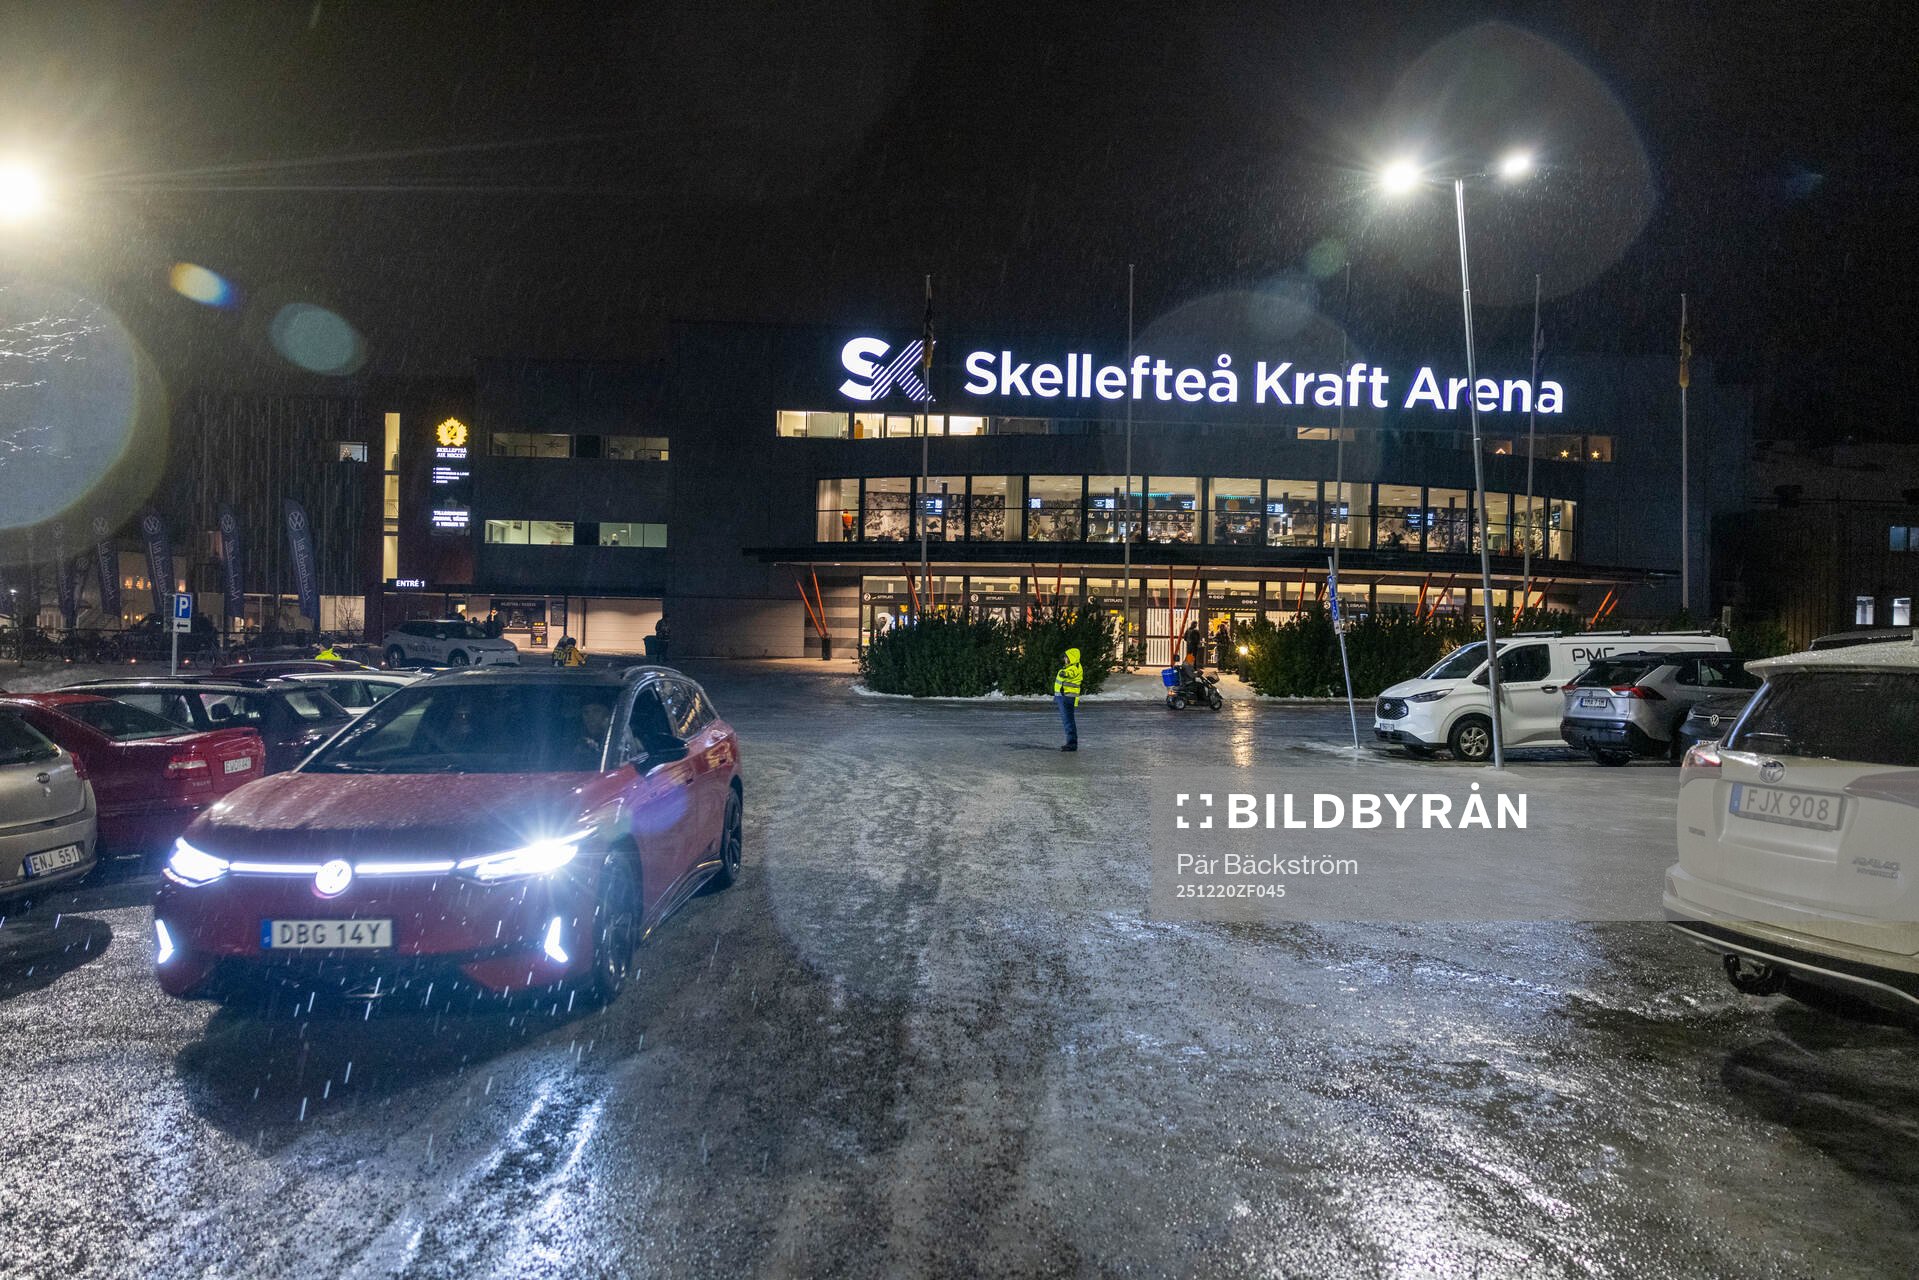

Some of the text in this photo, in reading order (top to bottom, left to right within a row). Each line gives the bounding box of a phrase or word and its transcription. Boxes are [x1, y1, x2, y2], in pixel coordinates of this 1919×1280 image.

[964, 351, 1564, 414] Skellefteå Kraft Arena
[396, 579, 420, 588] ENTRÉ
[178, 597, 188, 617] P
[1746, 787, 1830, 821] FJX 908
[31, 847, 78, 872] ENJ 551
[280, 923, 381, 944] DBG 14Y
